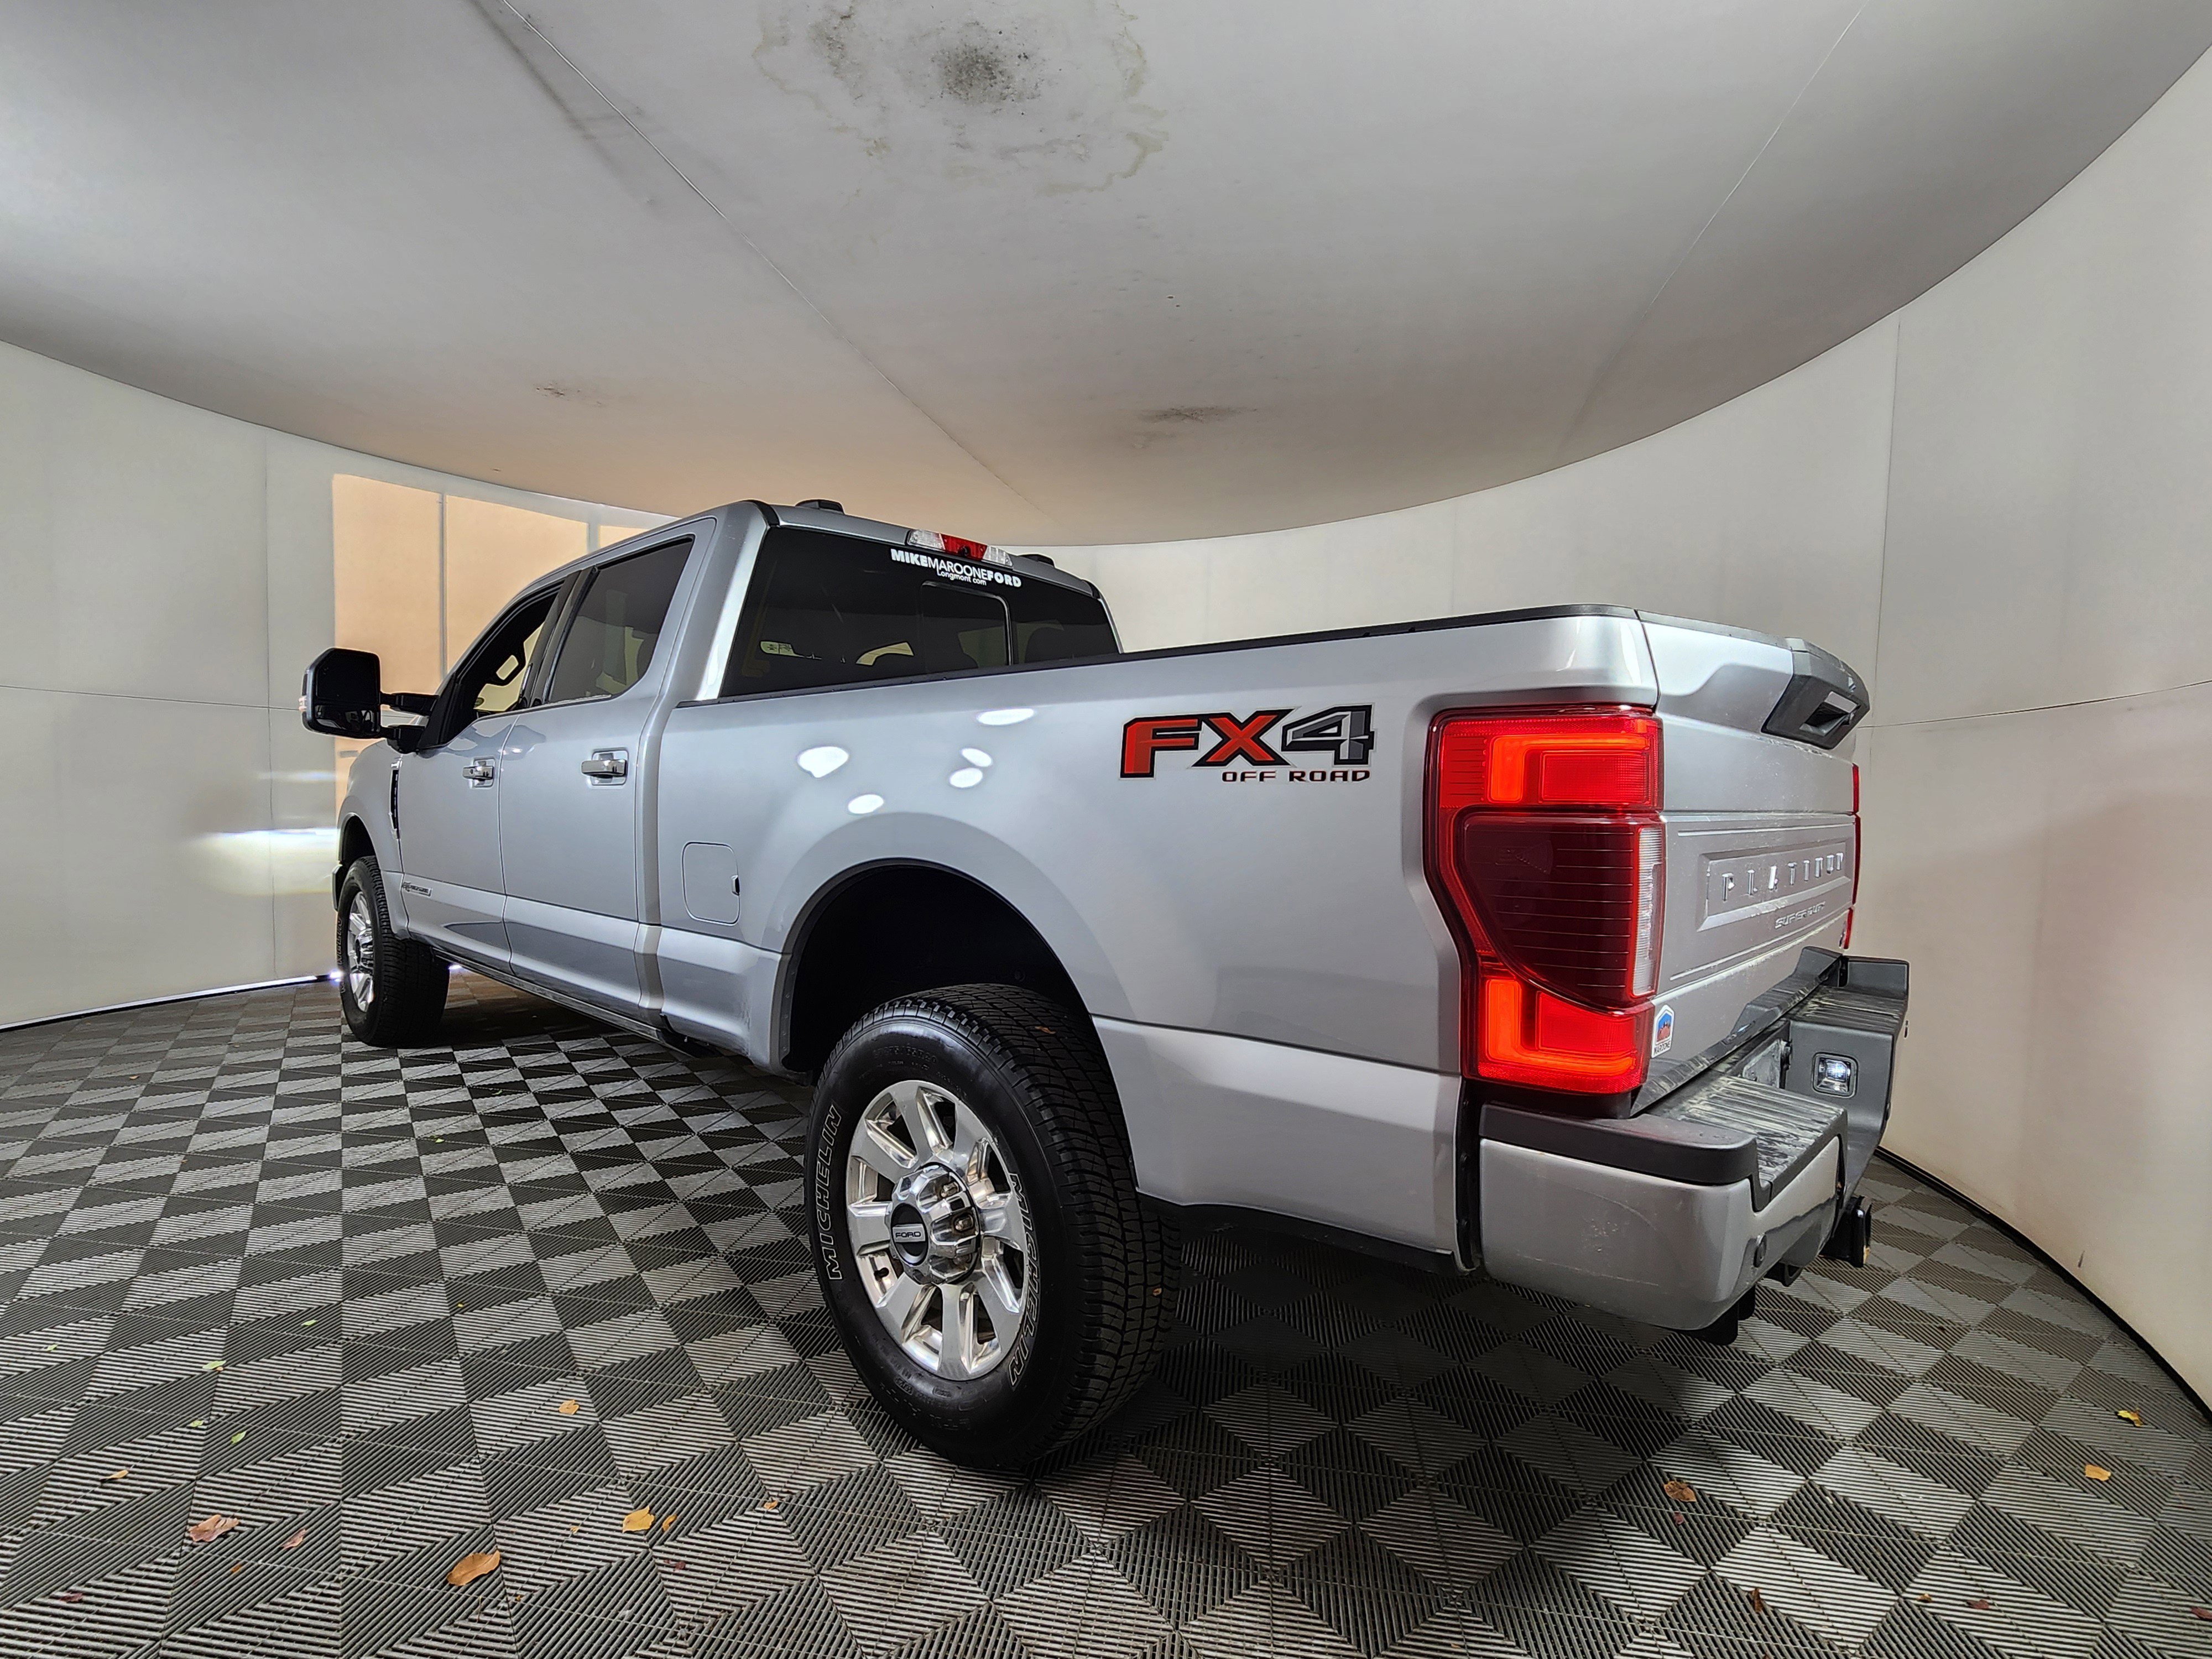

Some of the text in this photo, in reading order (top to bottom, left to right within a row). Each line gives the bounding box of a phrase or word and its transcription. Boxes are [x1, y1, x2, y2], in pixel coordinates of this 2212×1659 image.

[1120, 704, 1375, 778] FX4
[1222, 770, 1370, 782] OFF ROAD
[815, 1105, 843, 1280] MICHELIN
[1008, 1172, 1041, 1386] MICHELIN
